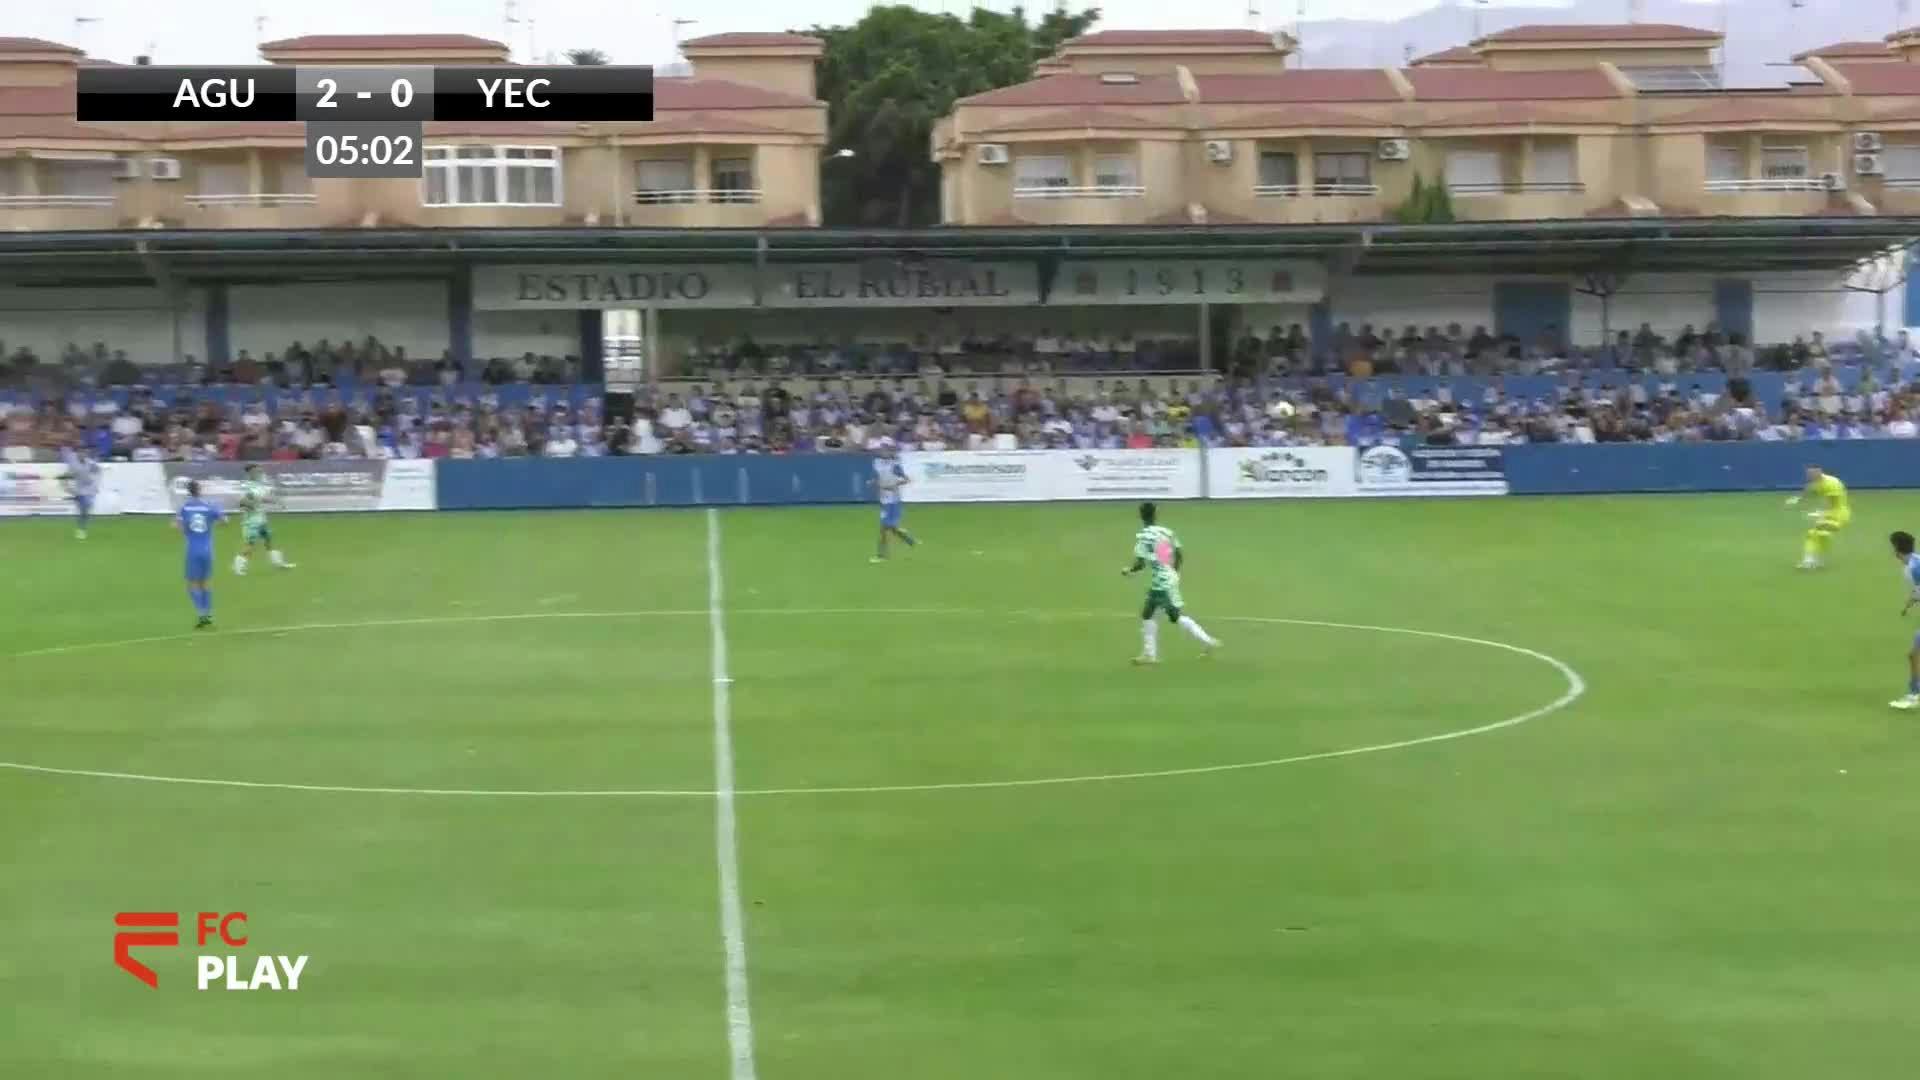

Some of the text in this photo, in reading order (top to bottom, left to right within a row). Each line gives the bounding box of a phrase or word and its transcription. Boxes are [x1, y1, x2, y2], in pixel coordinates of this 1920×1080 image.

[516, 269, 1246, 301] ESTADIO EL RUBIAL 1913
